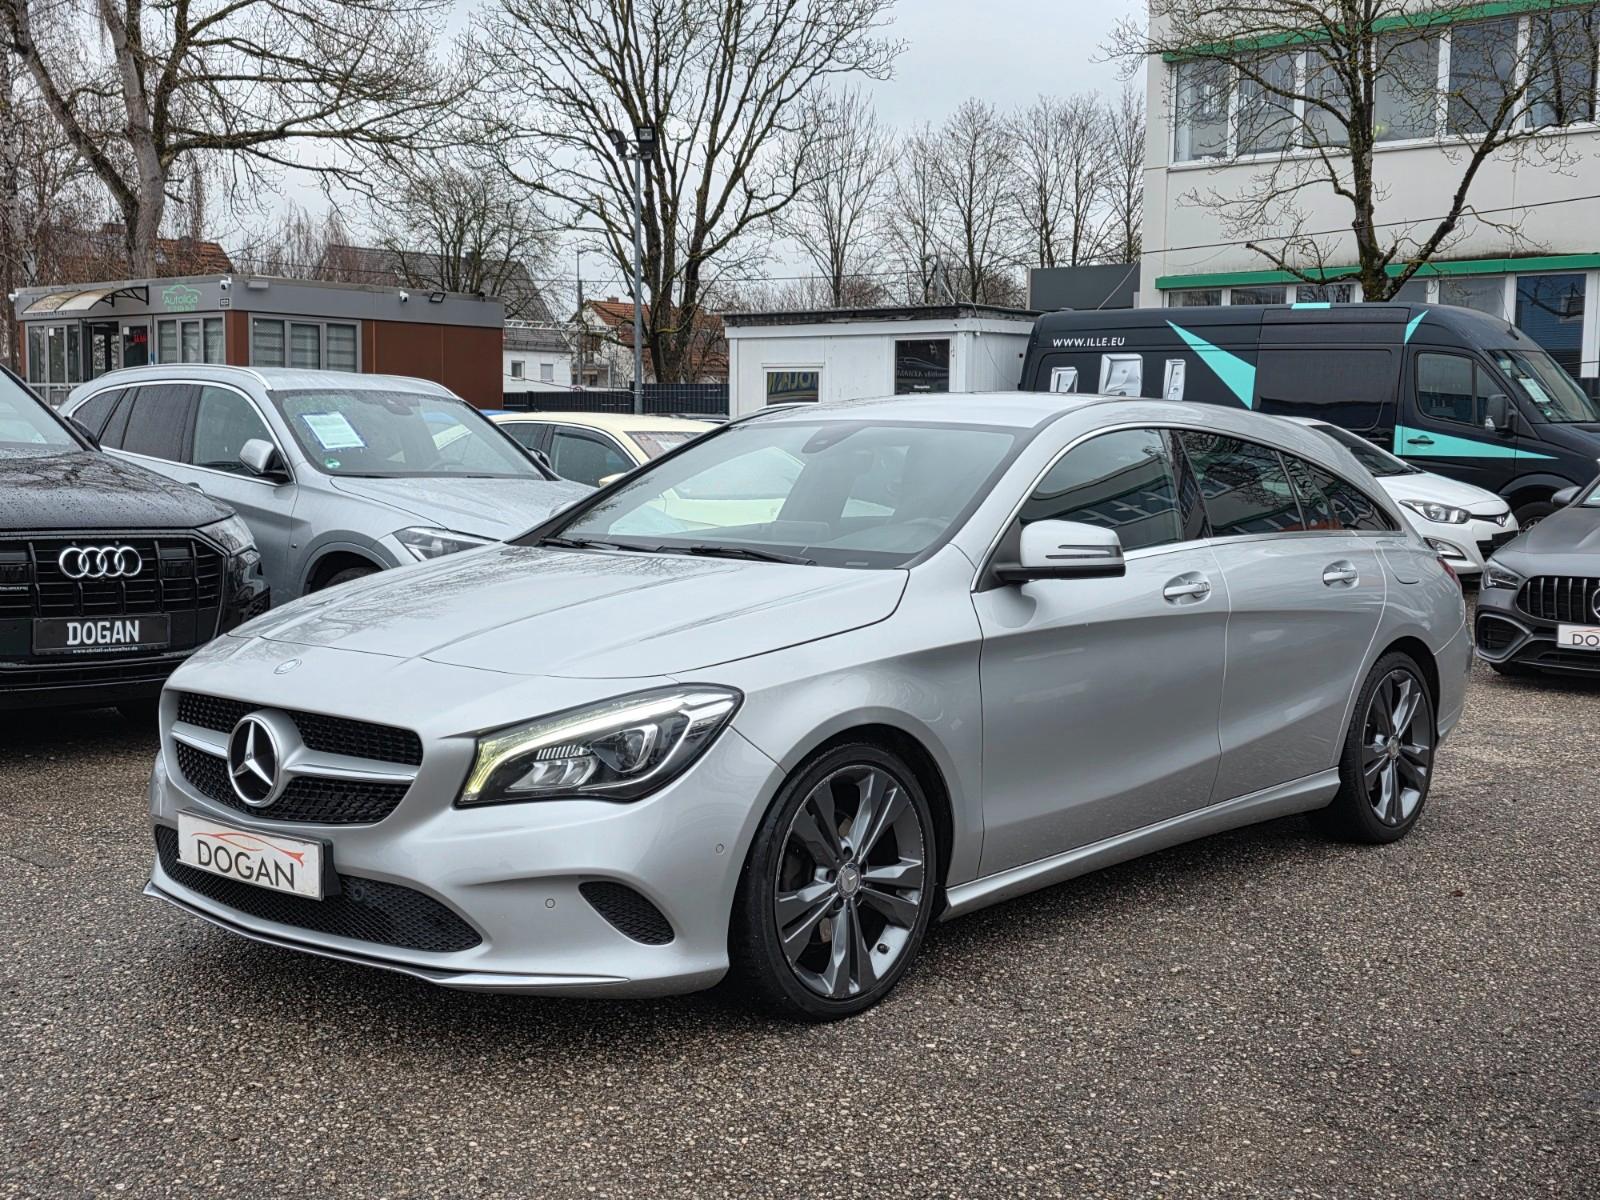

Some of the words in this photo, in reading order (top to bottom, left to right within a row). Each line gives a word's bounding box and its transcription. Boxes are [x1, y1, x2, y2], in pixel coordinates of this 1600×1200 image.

[1053, 337, 1125, 347] WWW.ILLE.EU
[67, 620, 139, 645] DOGAN
[1572, 633, 1600, 647] DO
[197, 839, 295, 890] DOGAN
